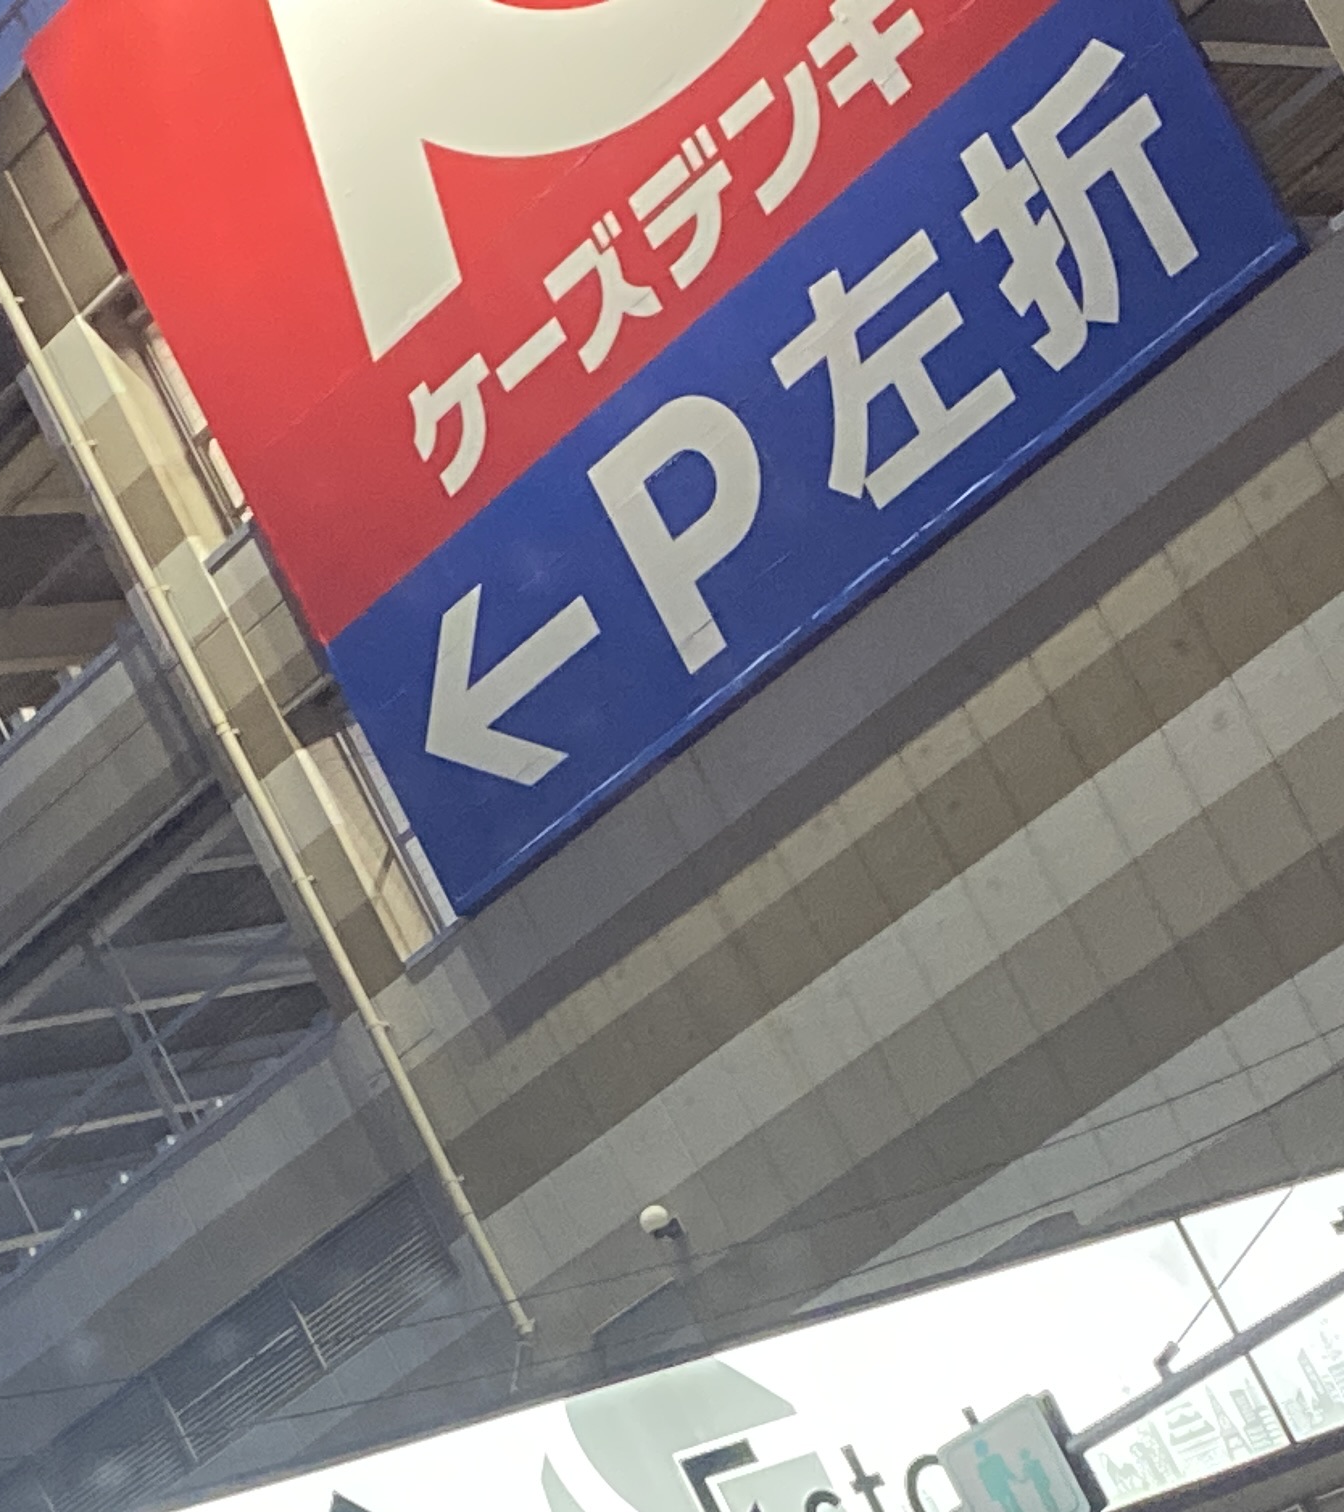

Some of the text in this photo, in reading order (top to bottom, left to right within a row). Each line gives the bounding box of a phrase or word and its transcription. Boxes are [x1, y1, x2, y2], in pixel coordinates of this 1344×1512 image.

[406, 0, 924, 497] ケーズデンキ
[586, 395, 763, 675] P
[771, 38, 1199, 511] 左折
